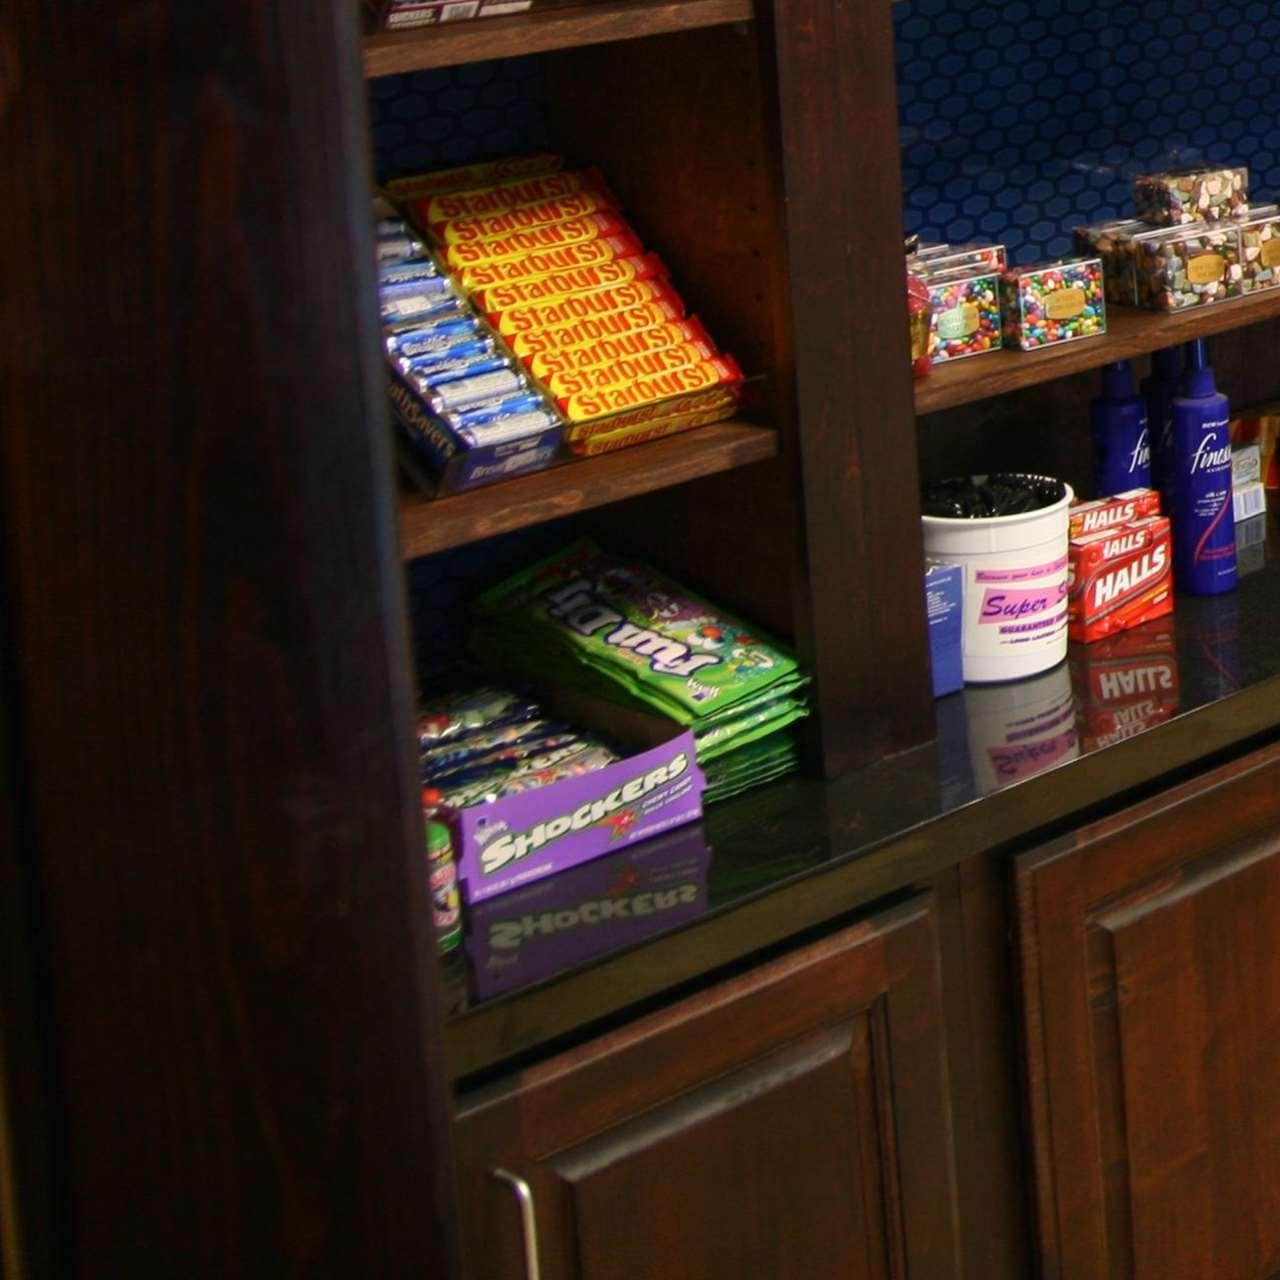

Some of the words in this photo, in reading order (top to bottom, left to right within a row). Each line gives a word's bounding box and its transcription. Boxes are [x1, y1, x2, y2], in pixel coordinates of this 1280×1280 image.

[453, 194, 595, 242] Starburst
[454, 217, 597, 263] Starburst
[469, 239, 612, 287] Starburst
[493, 260, 634, 307] Starburst
[508, 283, 650, 332] Starburst
[522, 304, 660, 354] Starburst
[539, 324, 679, 373] Starburst
[558, 344, 696, 395] Starburst
[576, 364, 713, 416] Starburst
[1190, 432, 1232, 475] fines
[1083, 502, 1136, 532] HALLS
[1094, 543, 1167, 609] HALLS
[981, 595, 1048, 620] Super
[480, 752, 690, 875] SHOCKERS
